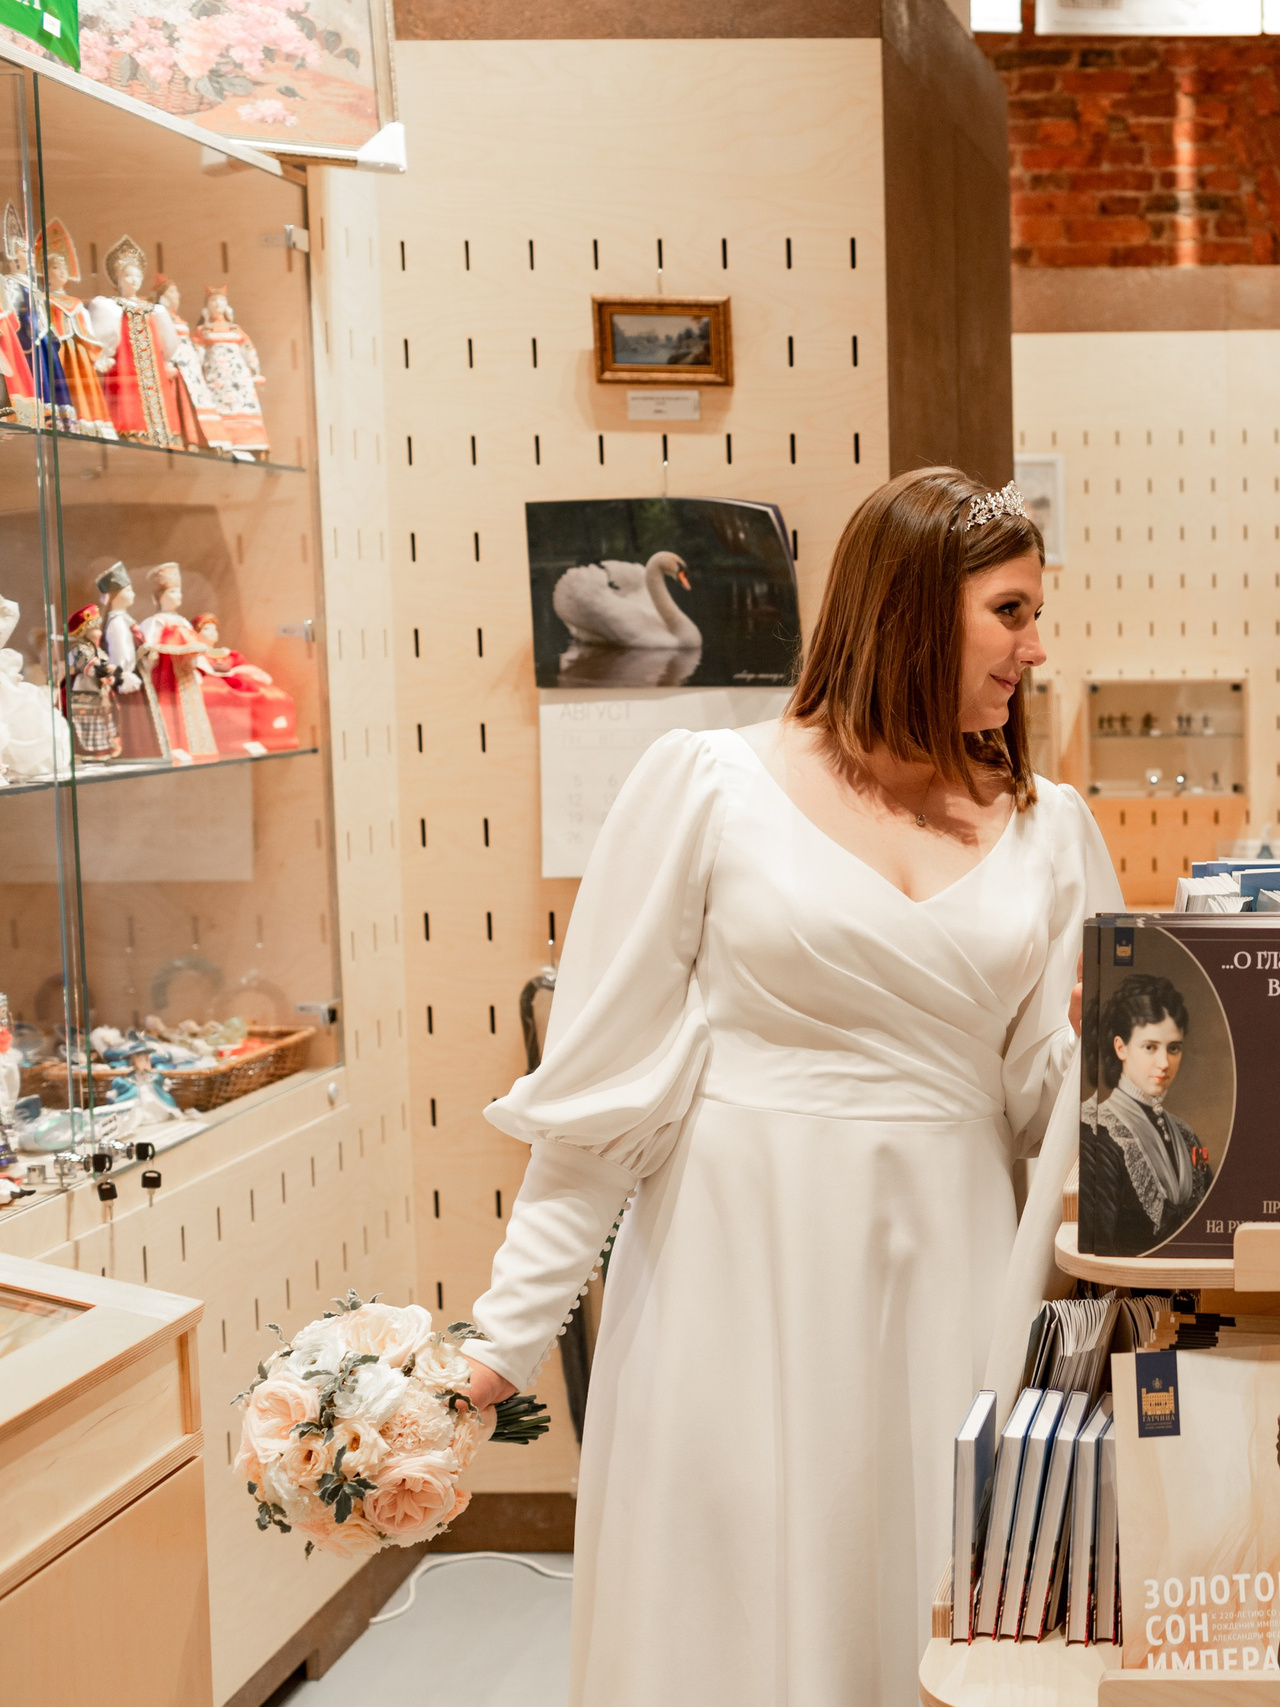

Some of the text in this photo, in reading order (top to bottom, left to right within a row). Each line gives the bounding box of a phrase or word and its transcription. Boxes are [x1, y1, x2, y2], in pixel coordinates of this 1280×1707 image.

[1205, 1219, 1224, 1234] НА
[1142, 1413, 1176, 1423] ГАТЧИНА
[1211, 1612, 1217, 1620] К
[1219, 1609, 1265, 1620] 220-ЛЕТИЮ
[1266, 1608, 1277, 1617] СО
[1144, 1611, 1210, 1647] СОН
[1211, 1620, 1255, 1631] РОЖДЕНИЯ
[1212, 1630, 1264, 1642] АЛЕКСАНДРЫ
